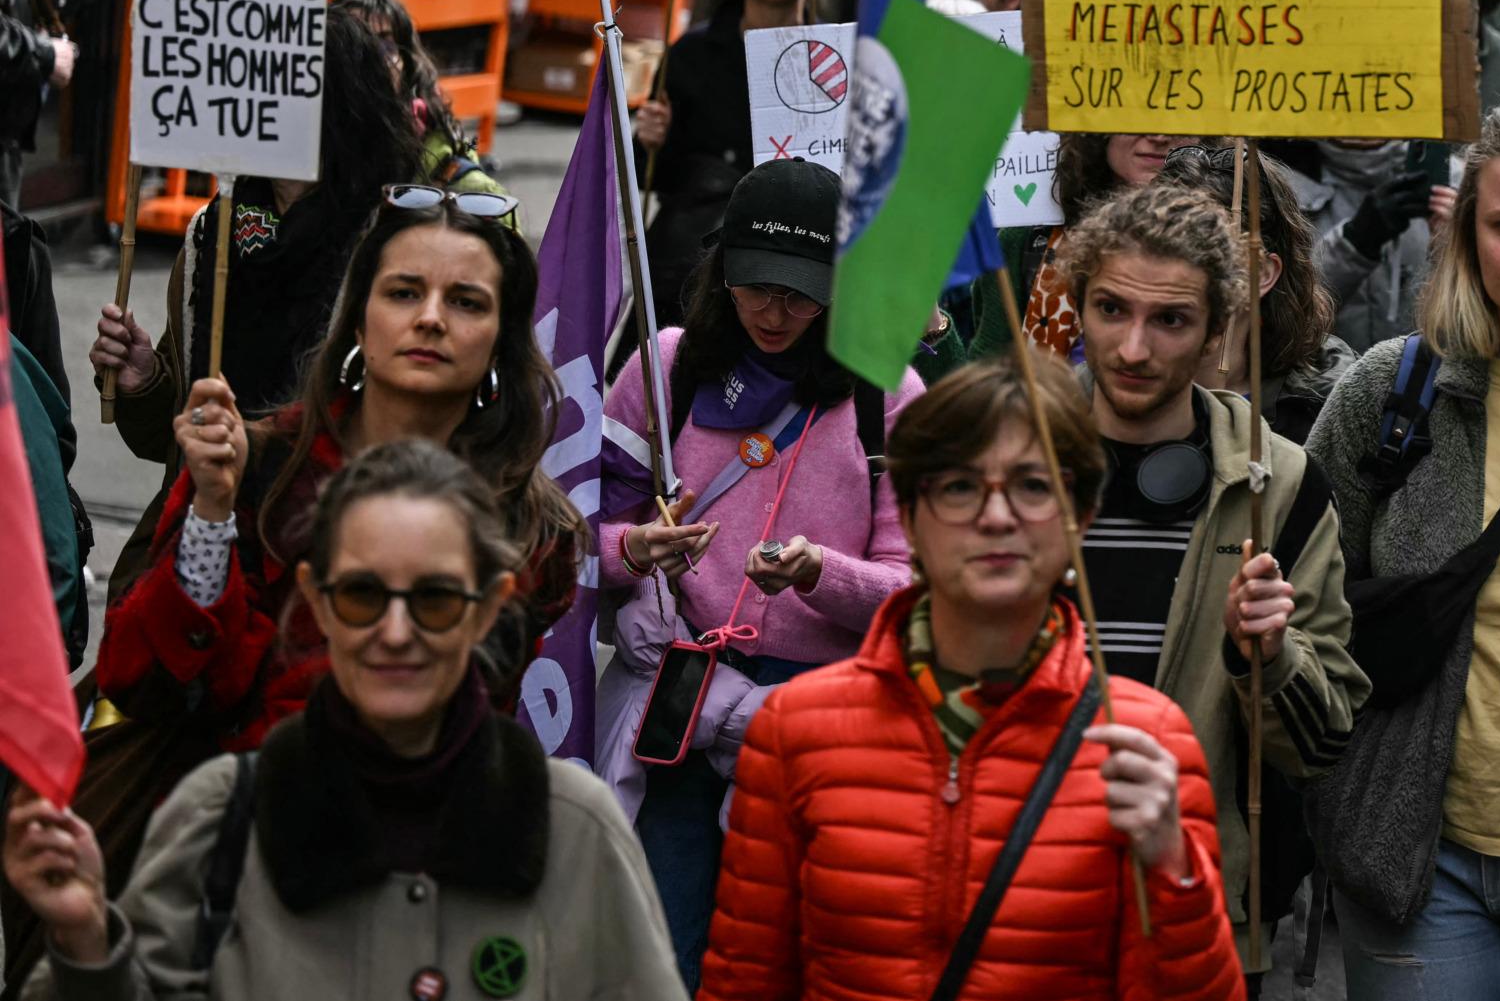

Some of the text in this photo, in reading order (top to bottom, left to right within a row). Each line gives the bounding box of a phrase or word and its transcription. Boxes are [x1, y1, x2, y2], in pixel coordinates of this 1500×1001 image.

[143, 36, 322, 98] LES HOMMES
[1063, 66, 1414, 113] SUR LES PROSTATES
[152, 85, 279, 141] ÇA TUE
[752, 221, 763, 229] les
[794, 226, 807, 235] les
